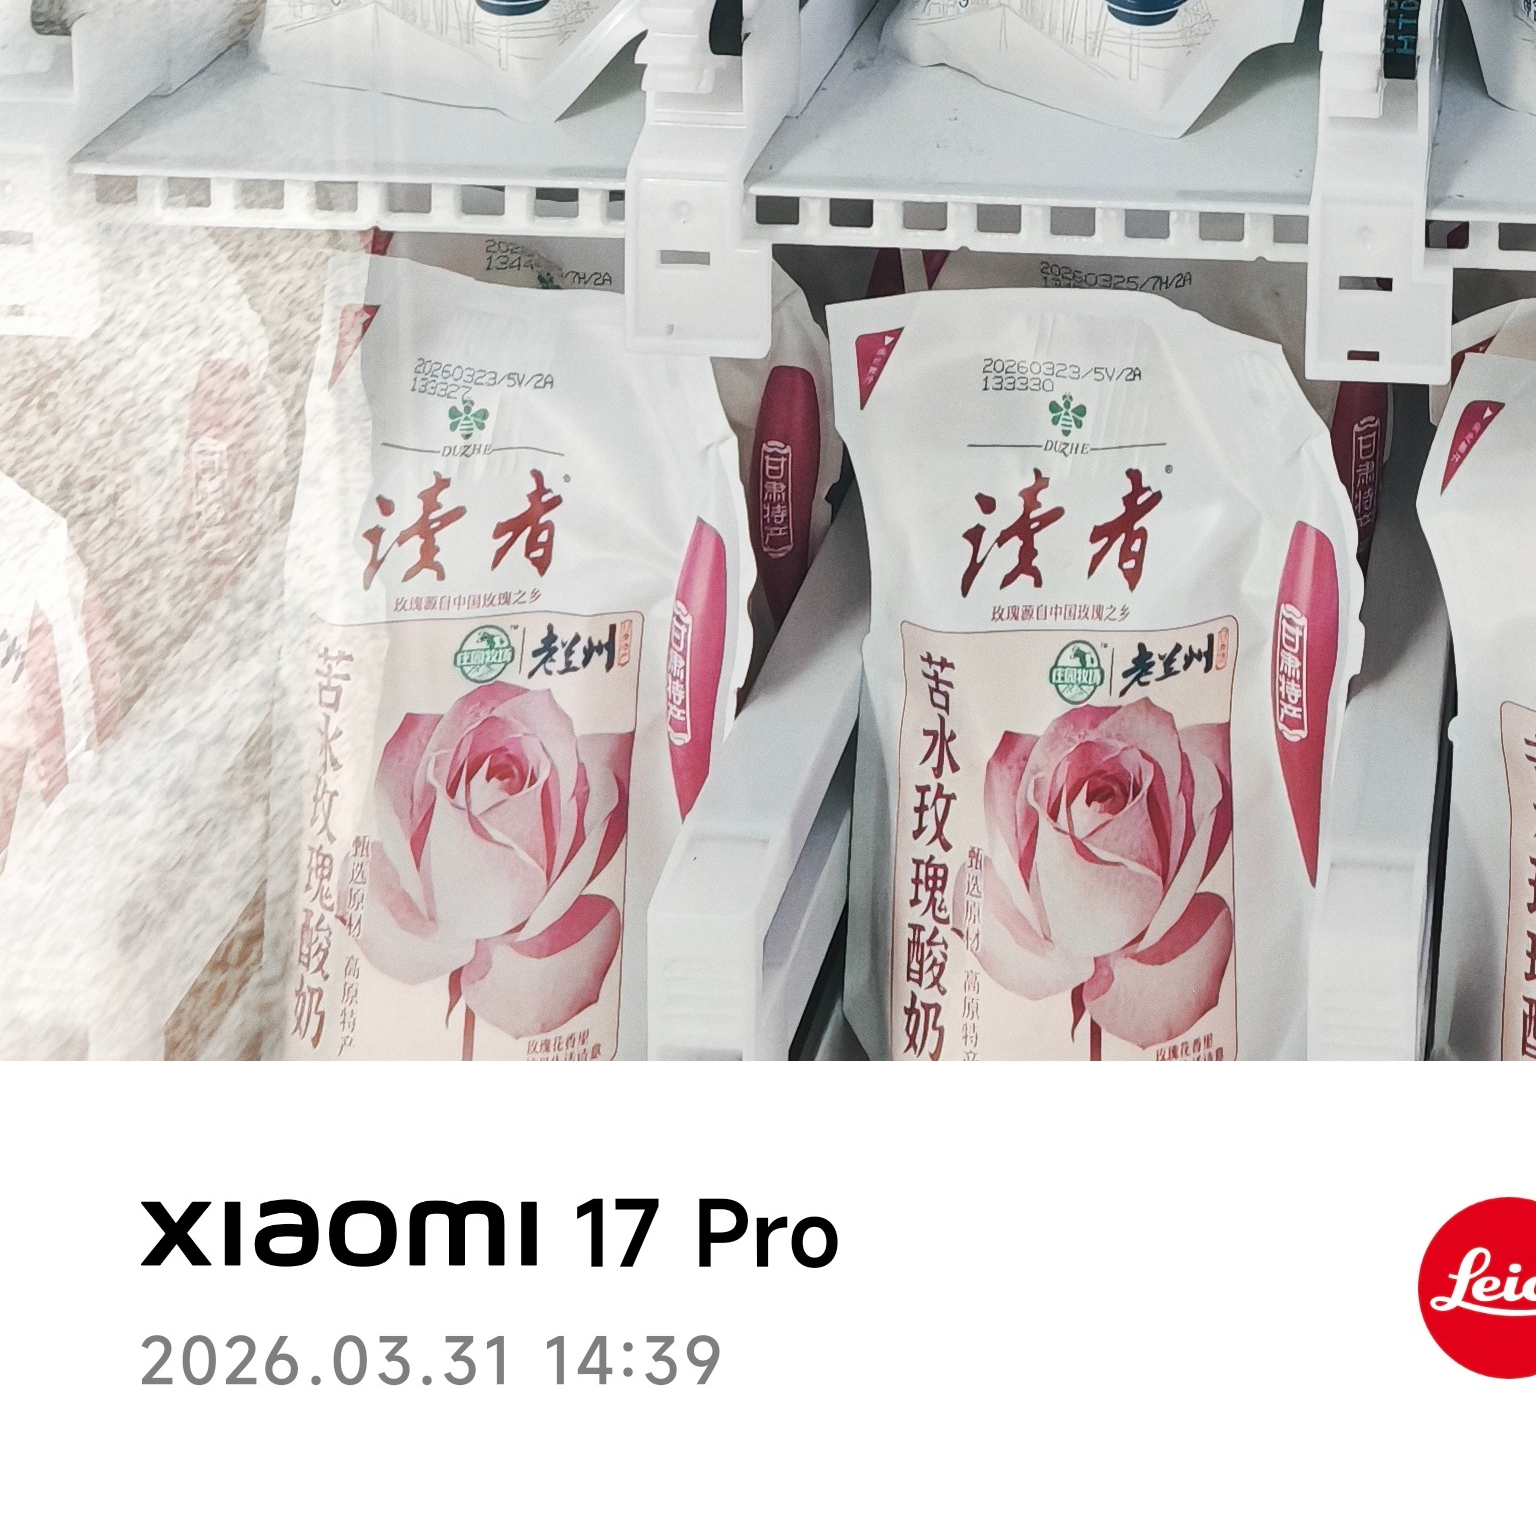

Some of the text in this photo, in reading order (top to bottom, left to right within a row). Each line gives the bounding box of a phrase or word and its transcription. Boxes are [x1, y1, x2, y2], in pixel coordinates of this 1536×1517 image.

[413, 357, 555, 391] 20260323/5V/2A
[982, 358, 1142, 382] 20260323/5V/2A
[982, 376, 1054, 393] 133330
[1043, 439, 1090, 457] DUZHE
[763, 451, 790, 545] 甘肃特产
[362, 468, 564, 592] 读者
[961, 467, 1164, 598] 读者
[393, 586, 542, 614] 玫瑰源自中国玫瑰之乡
[991, 604, 1131, 623] 玫瑰源自中国玫瑰之乡
[527, 622, 617, 679] 老兰州
[667, 611, 692, 724] 甘肃特产
[1051, 666, 1100, 686] 庄园牧场
[1118, 632, 1215, 697] 老兰州
[290, 648, 353, 1049] 苦水玫瑰酸奶
[903, 652, 960, 1061] 苦水玫瑰酸奶
[338, 955, 360, 1057] 高原特产
